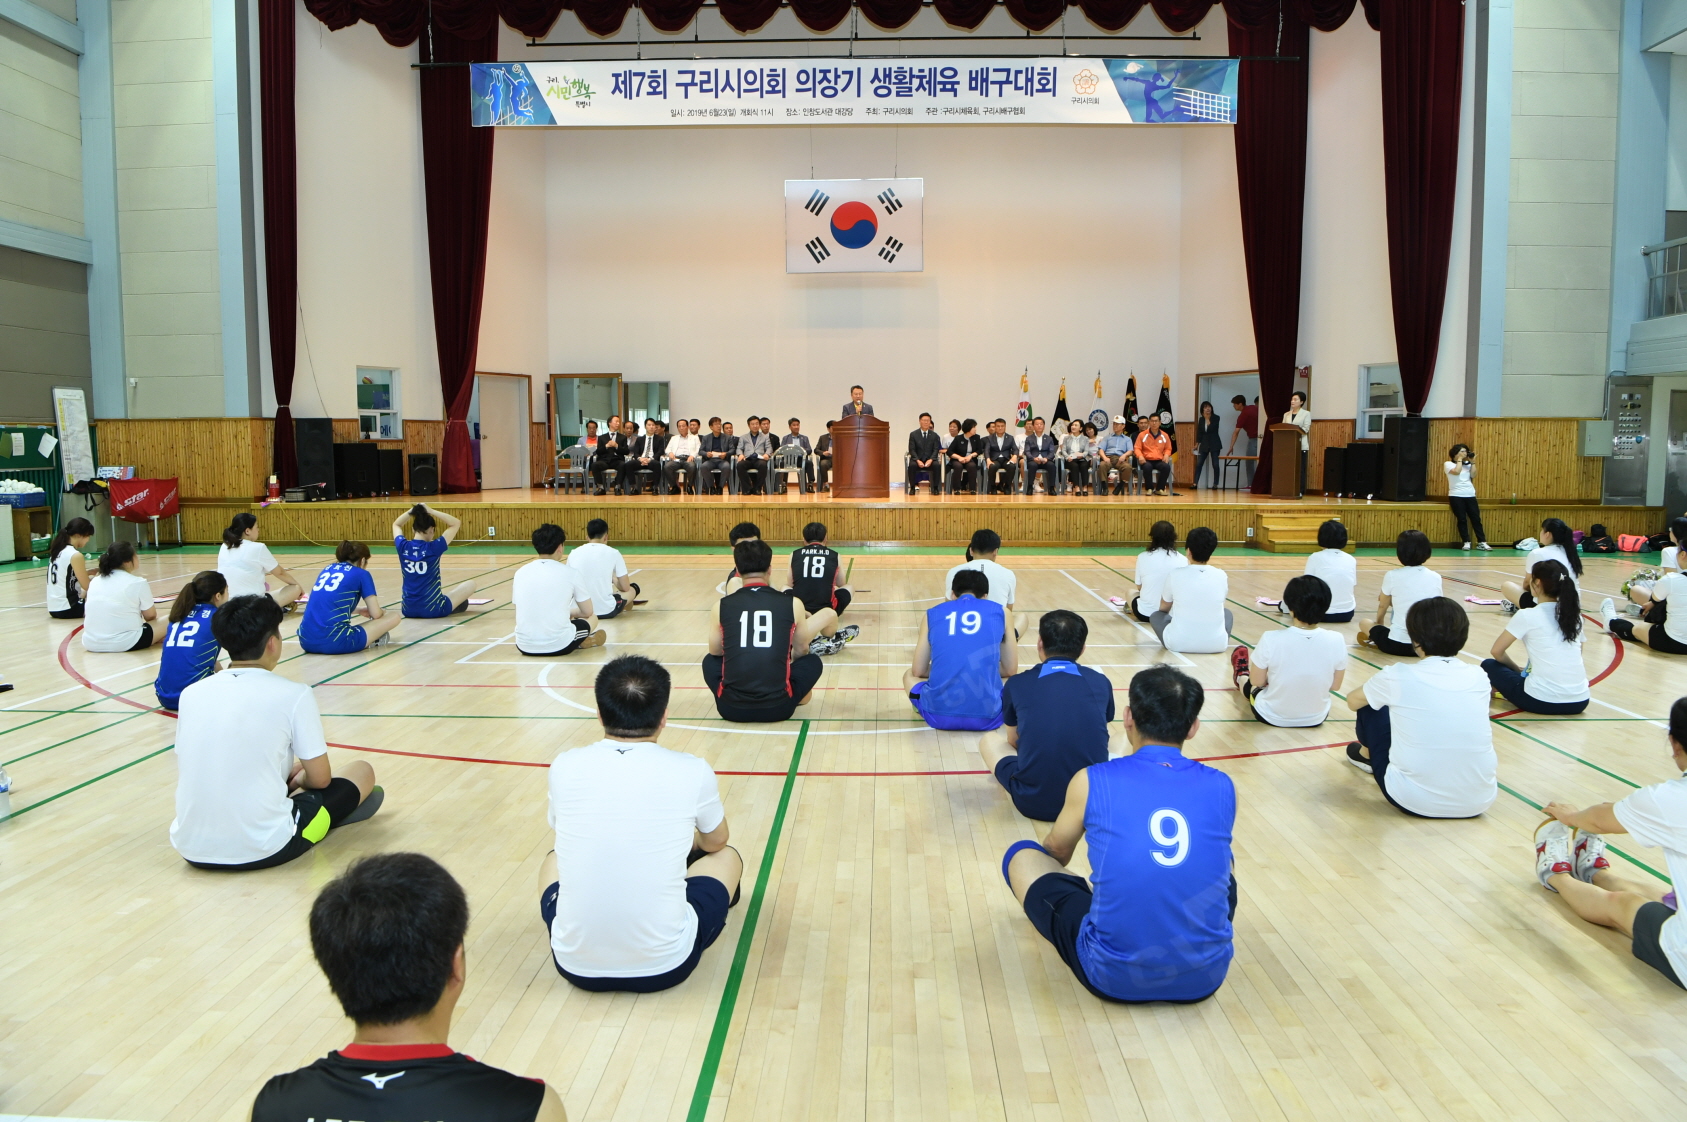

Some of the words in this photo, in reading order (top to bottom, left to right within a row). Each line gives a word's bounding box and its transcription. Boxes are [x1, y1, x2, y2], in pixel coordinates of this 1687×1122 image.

[611, 68, 668, 100] 제7회
[675, 67, 787, 100] 구리시의회
[795, 66, 862, 99] 의장기
[869, 65, 961, 98] 생활체육
[968, 65, 1058, 98] 배구대회
[1071, 96, 1100, 105] 구리시의회
[670, 109, 685, 118] 일시:
[686, 109, 708, 117] 2019년
[740, 108, 759, 117] 개회식
[760, 108, 774, 117] 11시
[785, 108, 801, 117] 장소:
[802, 108, 834, 117] 인창도서관
[834, 107, 854, 117] 대강당
[865, 107, 881, 116] 주최:
[882, 107, 914, 116] 구리시의회
[982, 107, 1026, 116] 구리시배구협회
[404, 560, 428, 574] 30
[803, 556, 826, 578] 18
[313, 572, 345, 592] 33
[739, 610, 773, 648] 18
[945, 611, 982, 636] 19
[166, 621, 200, 648] 12
[1148, 807, 1191, 869] 9
